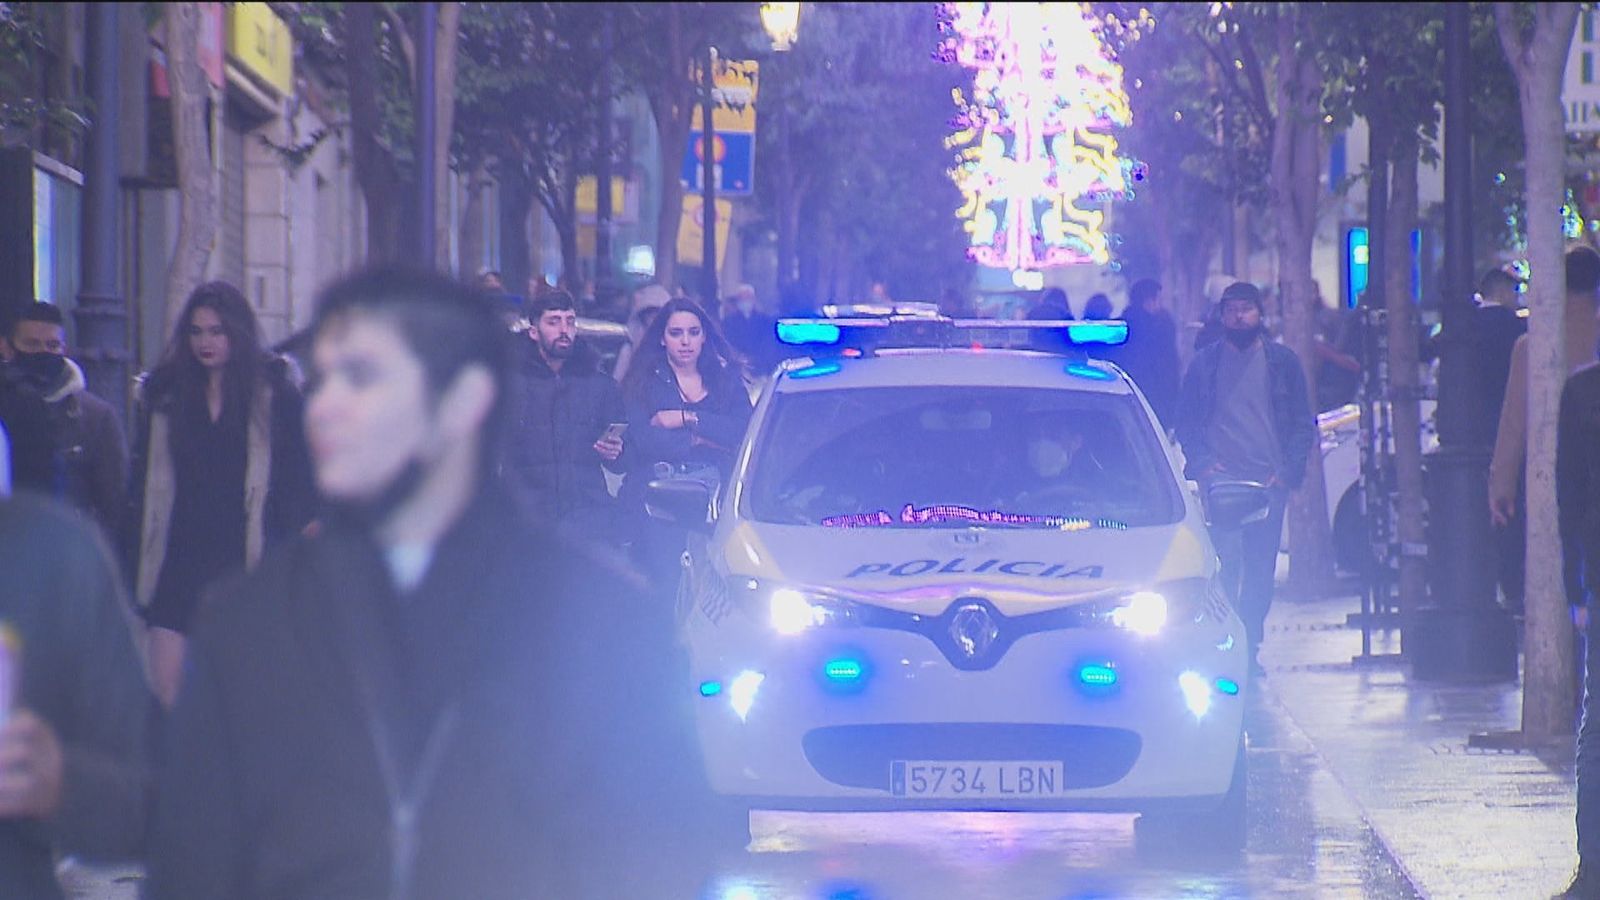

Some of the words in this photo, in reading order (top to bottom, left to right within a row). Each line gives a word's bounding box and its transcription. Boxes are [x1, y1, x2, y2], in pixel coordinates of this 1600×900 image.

[845, 557, 1105, 579] POLICIA
[910, 766, 987, 794] 5734
[999, 766, 1055, 794] LBN
